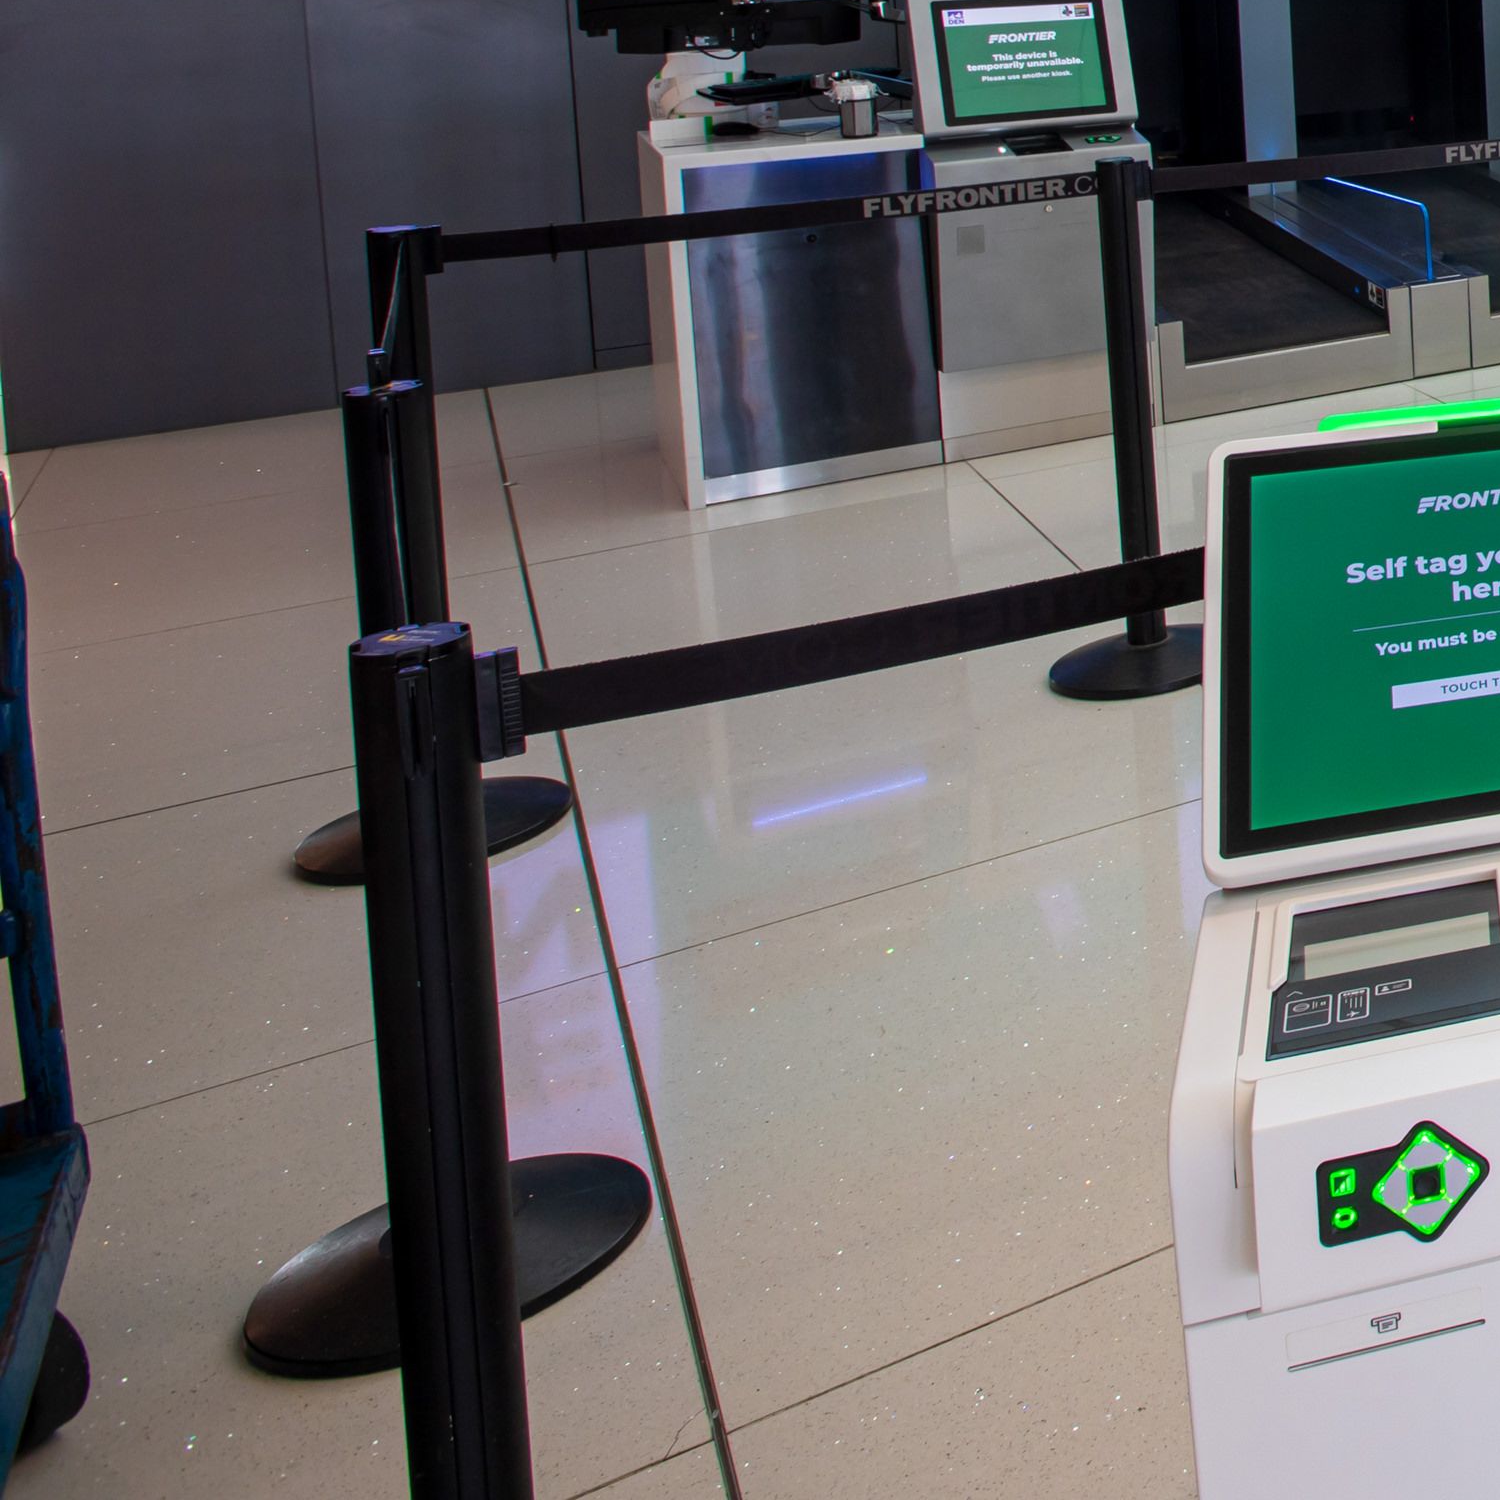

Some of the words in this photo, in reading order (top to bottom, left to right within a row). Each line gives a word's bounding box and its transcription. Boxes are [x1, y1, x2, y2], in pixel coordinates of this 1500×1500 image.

[988, 31, 1057, 44] FRONTIER
[992, 53, 1014, 61] This
[1015, 51, 1047, 60] device
[1049, 50, 1058, 58] is
[967, 60, 1025, 72] temporarily
[1027, 57, 1084, 68] unavailable.
[981, 74, 1006, 82] Please
[1022, 72, 1050, 80] another
[864, 176, 1097, 218] FLYFRONTIER.C
[1346, 556, 1408, 584] Self
[1415, 553, 1468, 576] tag
[1375, 640, 1412, 656] You
[1418, 631, 1468, 651] must
[1473, 628, 1497, 644] be
[1440, 679, 1488, 695] TOUCH
